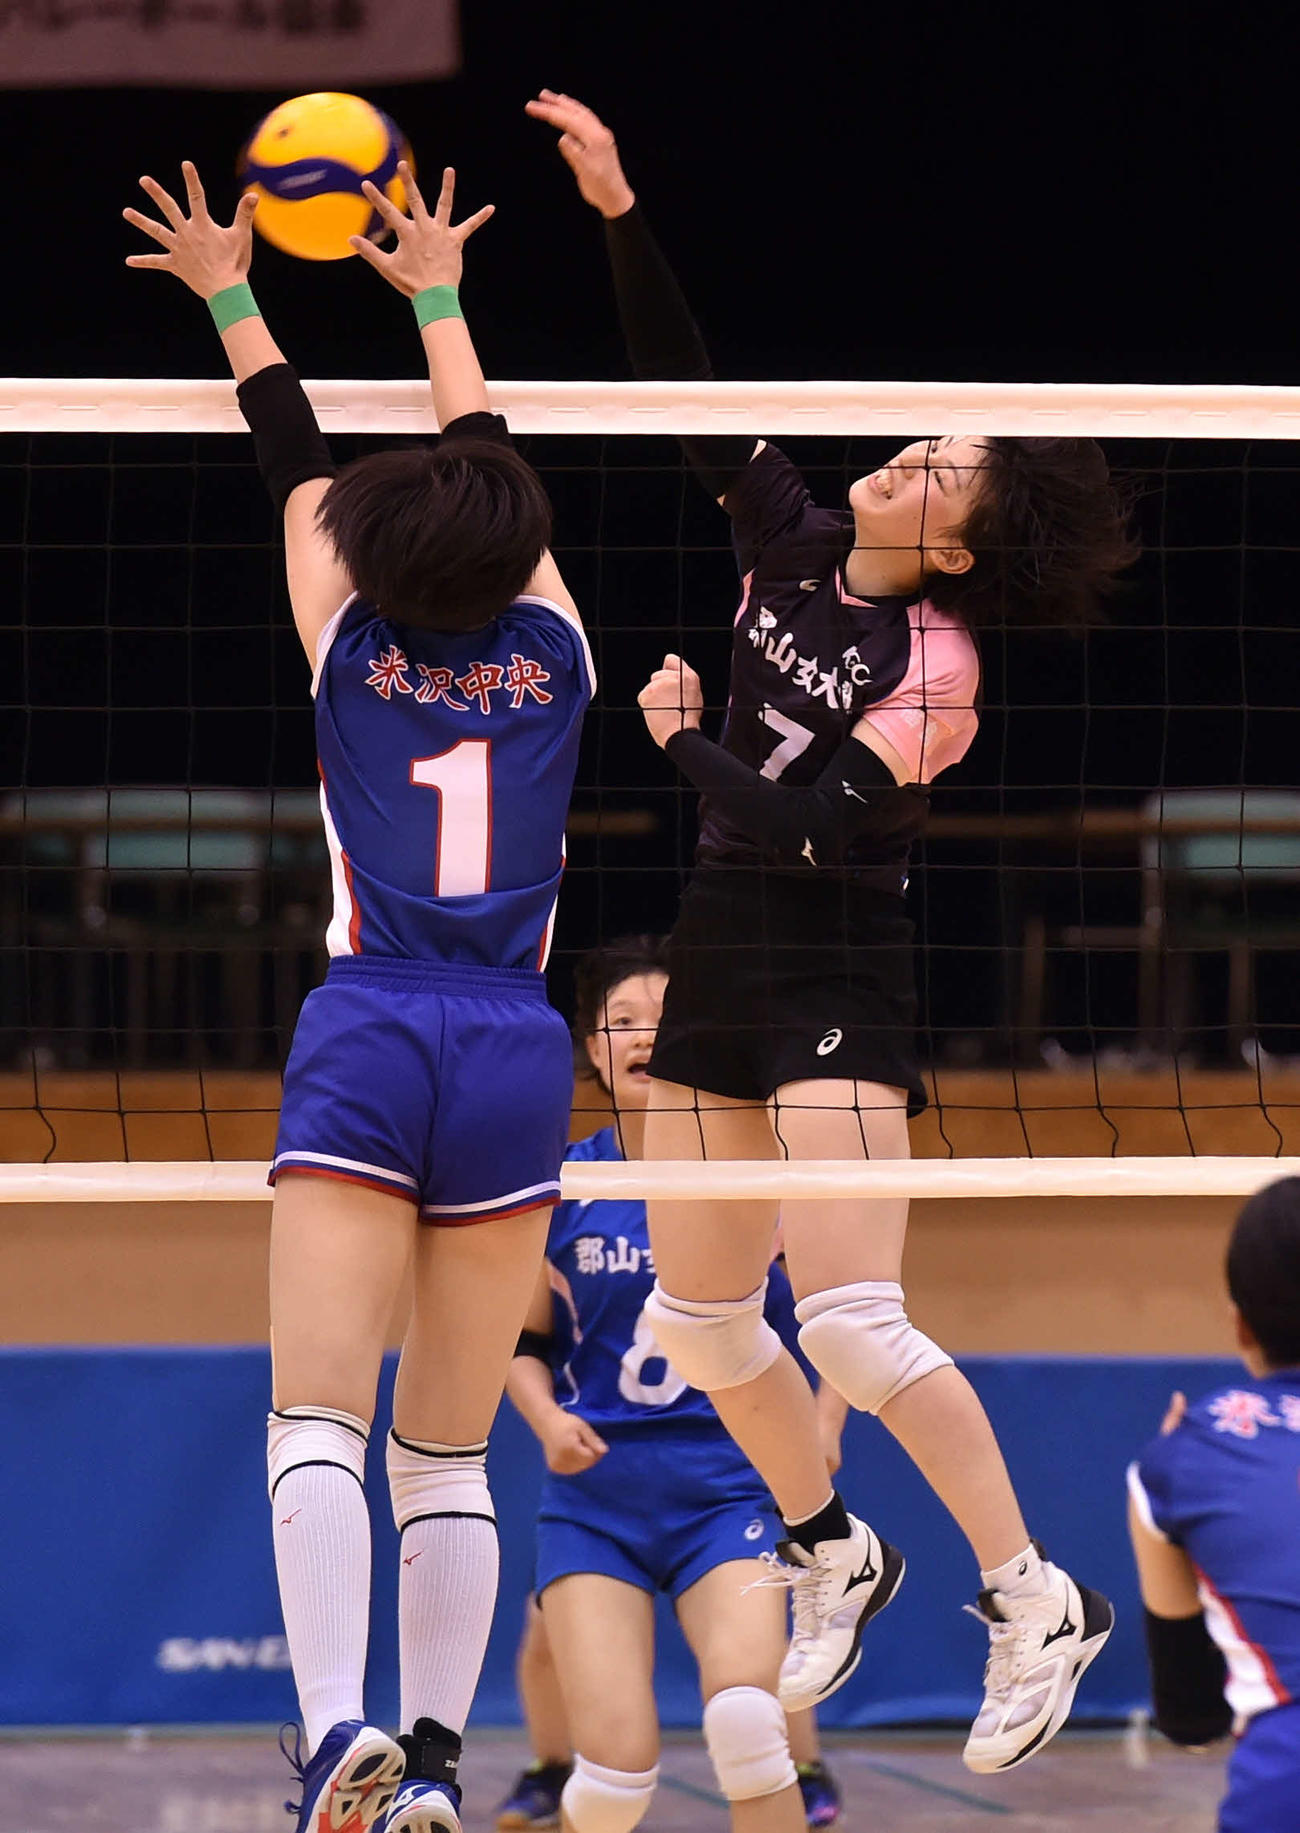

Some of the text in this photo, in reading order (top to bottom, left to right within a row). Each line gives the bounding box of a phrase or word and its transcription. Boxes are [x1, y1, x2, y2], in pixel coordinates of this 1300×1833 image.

[365, 644, 553, 715] 米沢中央
[757, 702, 816, 782] 7
[409, 738, 492, 897] 1
